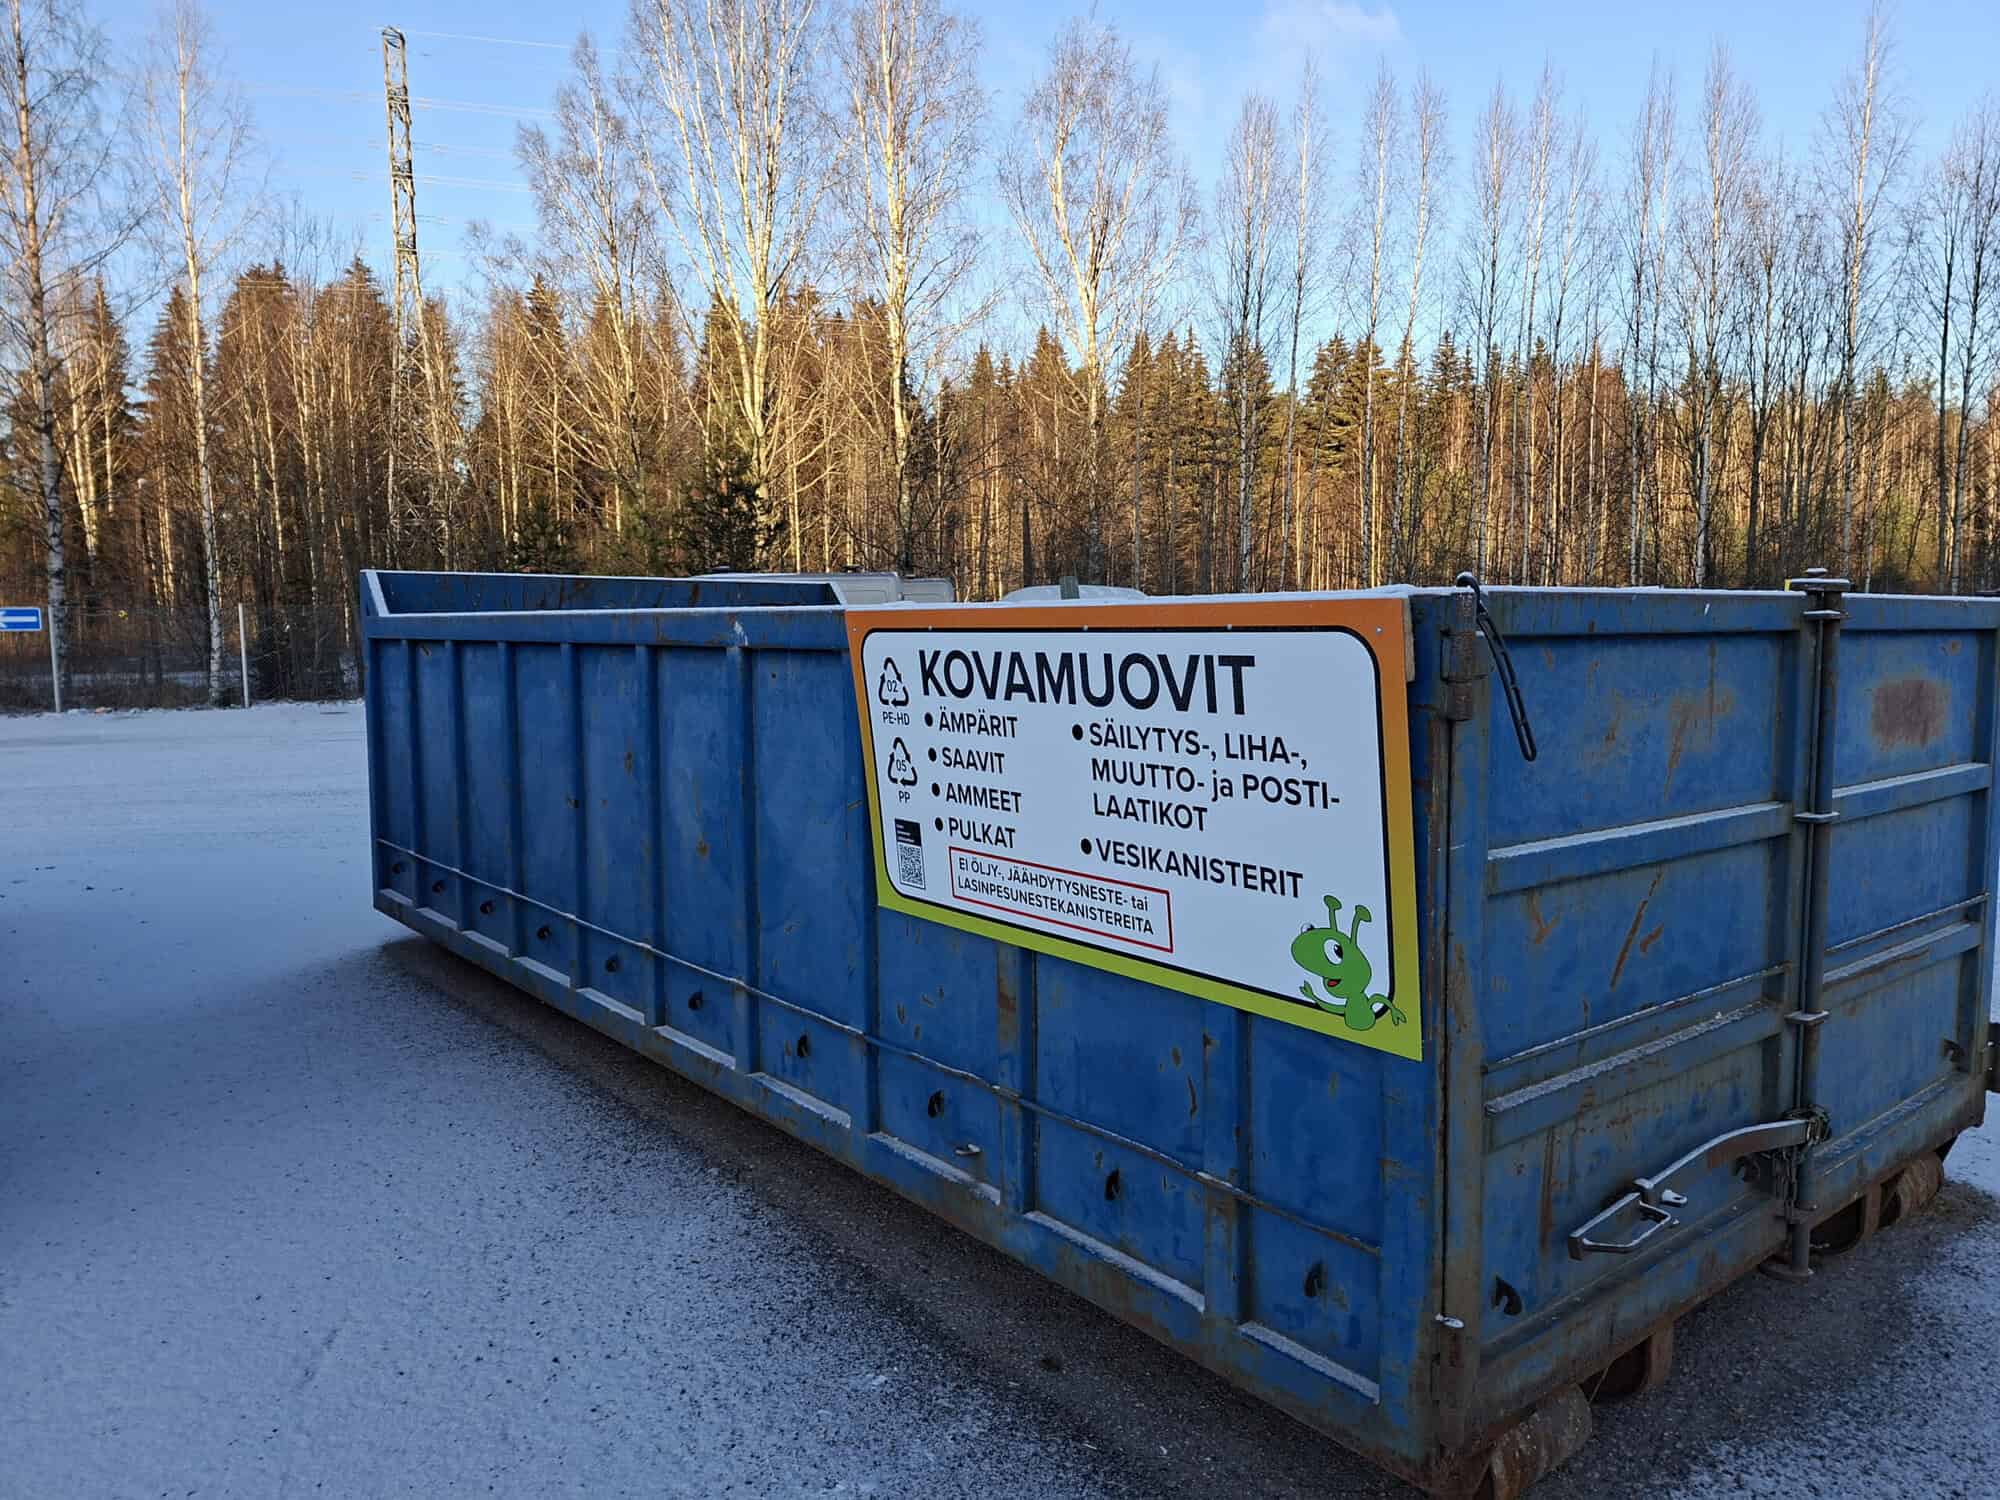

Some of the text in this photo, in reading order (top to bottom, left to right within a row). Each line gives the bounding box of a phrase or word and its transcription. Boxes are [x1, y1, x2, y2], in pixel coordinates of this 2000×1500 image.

[886, 679, 899, 693] 02
[919, 649, 1256, 715] KOVAMUOVIT
[882, 711, 910, 726] PE-HD
[939, 705, 1018, 738] ÄMPÄRIT
[942, 747, 1005, 774] SAAVIT
[1089, 718, 1308, 770] SÄILYTYS-, LIHA-,
[896, 759, 907, 773] 05
[898, 790, 911, 804] PP
[946, 783, 1021, 813] AMMEET
[1091, 758, 1340, 809] MUUTTO- ja POSTI-
[1093, 793, 1208, 831] LAATIKOT
[949, 817, 1016, 848] PULKAT
[958, 857, 1148, 911] EI ÖLJY-, JÄÄHDYTYSNESTE- tai
[1096, 838, 1303, 899] VESIKANISTERIT
[958, 876, 1154, 935] LASINPESUNESTEKANISTEREITA
